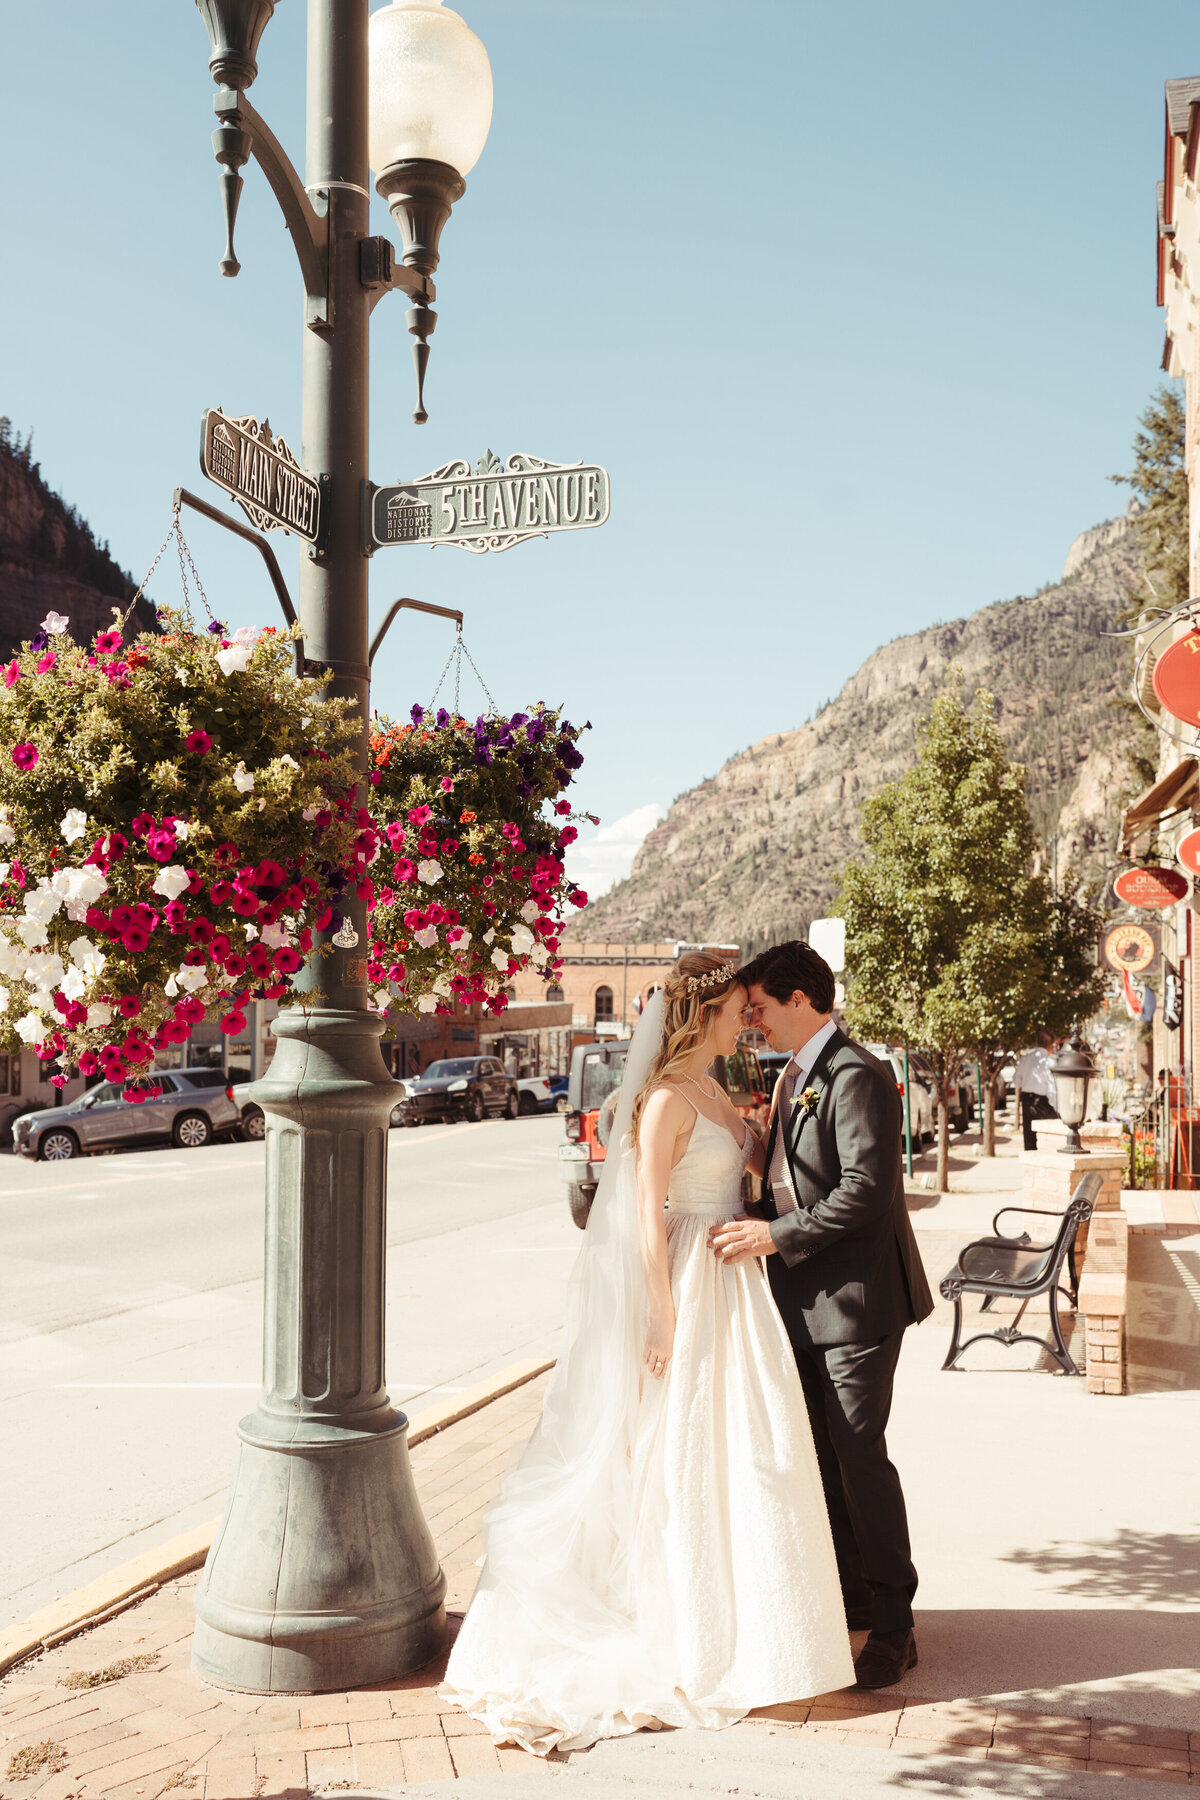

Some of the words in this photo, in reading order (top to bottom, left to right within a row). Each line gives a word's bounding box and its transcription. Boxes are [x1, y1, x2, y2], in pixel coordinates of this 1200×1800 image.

[211, 438, 236, 461] NATIONAL
[211, 449, 236, 473] HISTORIC
[211, 459, 236, 484] DISTRICT
[238, 437, 273, 508] MAIN
[275, 464, 317, 534] STREET
[387, 506, 431, 519] NATIONAL
[441, 484, 488, 534] 5TH
[489, 472, 599, 529] AVENUE
[387, 516, 431, 529] HISTORIC
[387, 526, 431, 539] DISTRICT
